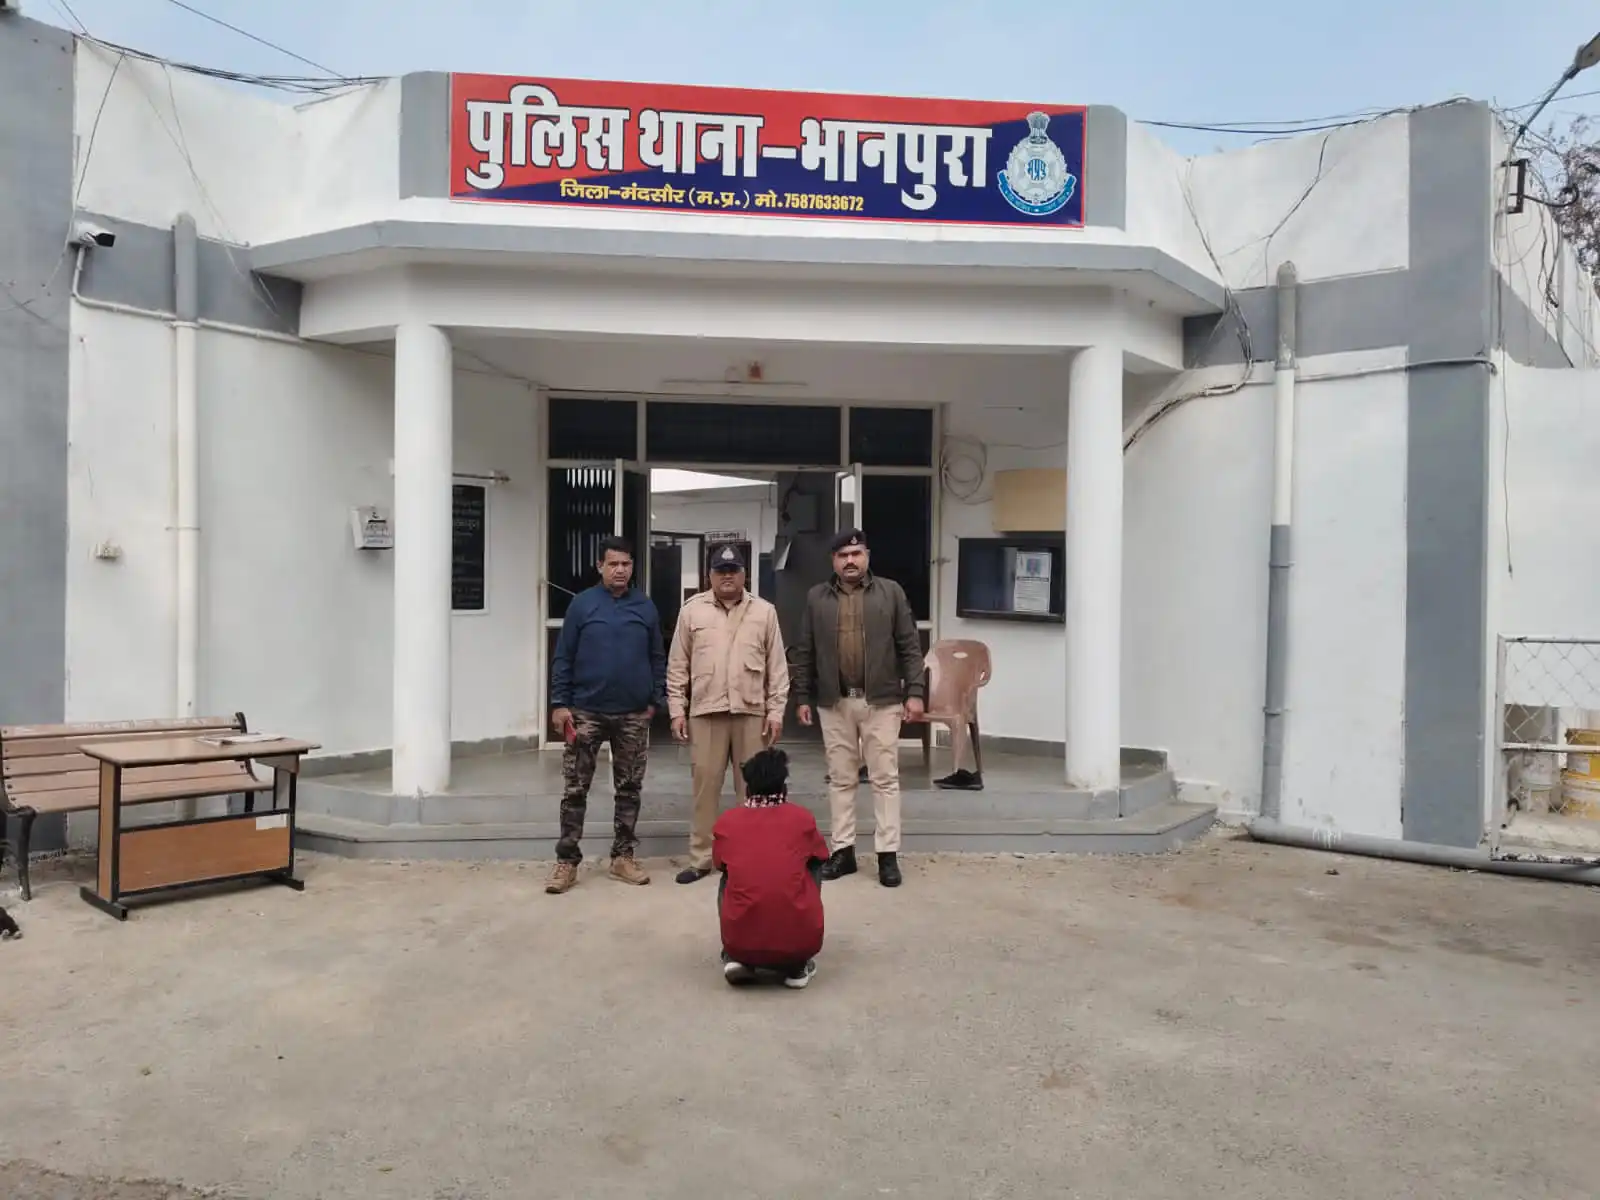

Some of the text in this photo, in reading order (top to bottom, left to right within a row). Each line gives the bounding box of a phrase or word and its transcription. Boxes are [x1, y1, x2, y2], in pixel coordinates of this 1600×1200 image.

[466, 83, 630, 190] पुलिस
[688, 187, 750, 209] (म.प्र.)
[754, 189, 864, 211] मो.7587633672
